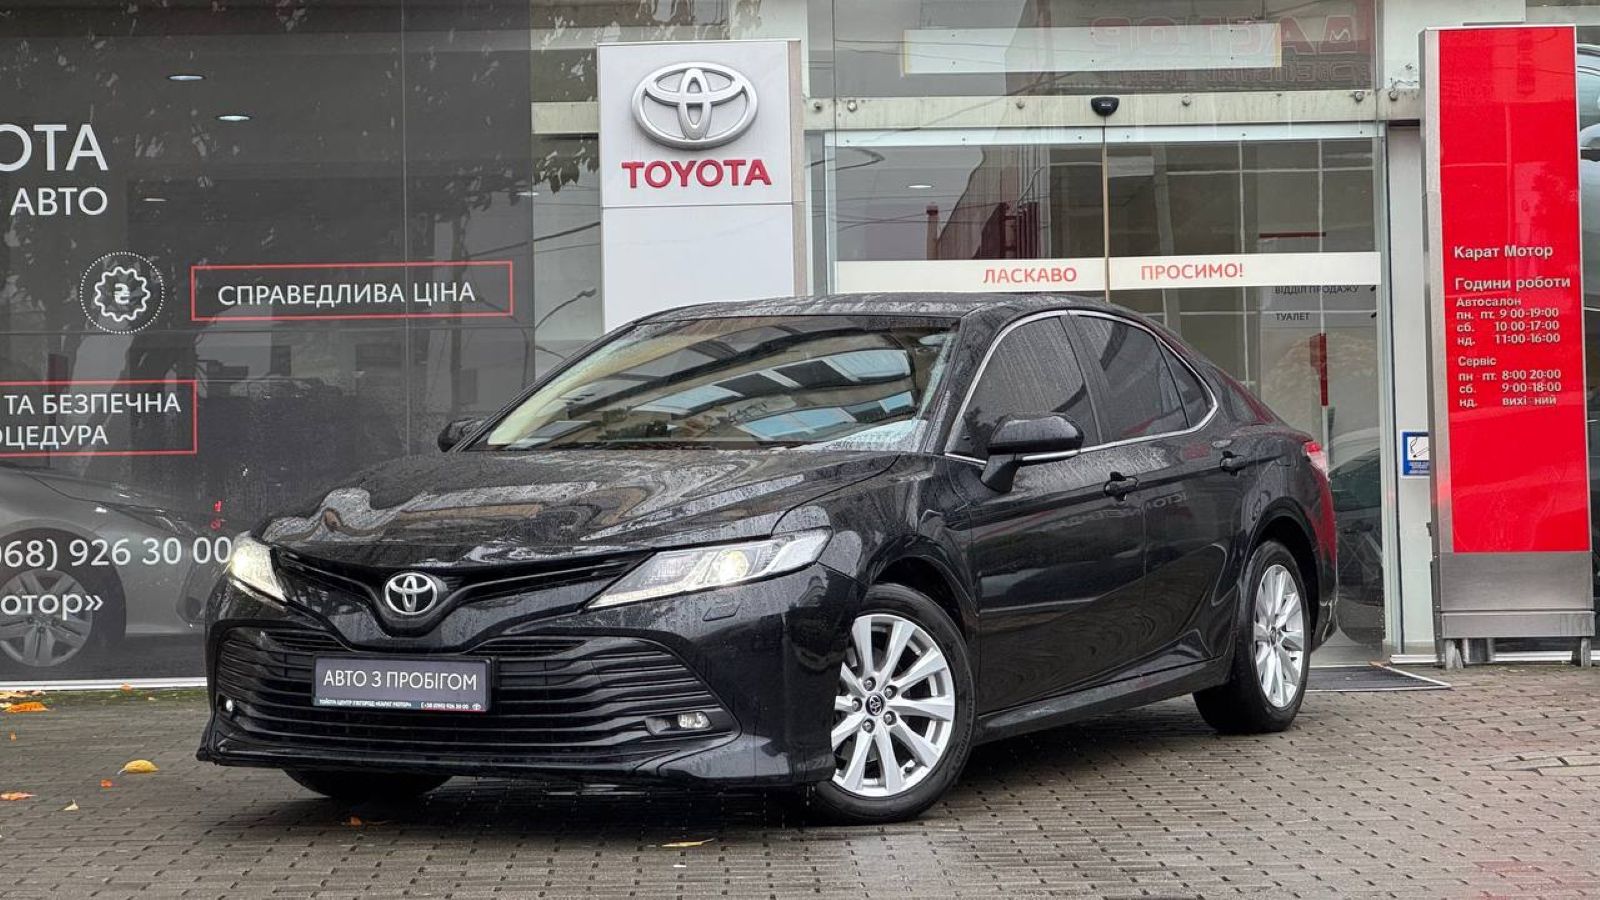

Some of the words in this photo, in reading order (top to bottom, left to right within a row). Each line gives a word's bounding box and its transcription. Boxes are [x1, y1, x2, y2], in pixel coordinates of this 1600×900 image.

[621, 159, 772, 189] TOYOTA
[9, 186, 108, 216] АВТО
[1454, 245, 1500, 261] Карат
[1504, 244, 1553, 259] Мотор
[983, 267, 1077, 284] ЛАСКАВО
[1140, 263, 1243, 281] ПРОСИМО!
[1455, 278, 1511, 292] Години
[1516, 276, 1571, 292] роботи
[217, 283, 405, 309] СПРАВЕДЛИВА
[414, 281, 476, 306] ЦІНА
[1456, 297, 1522, 307] Автосалон
[1275, 312, 1310, 321] ТУАЛЕТ
[1456, 322, 1475, 332] сб.
[1457, 336, 1476, 346] нд.
[1458, 356, 1496, 367] Сервіс
[3, 394, 35, 415] ТА
[43, 392, 182, 415] БЕЗПЕЧНА
[1459, 398, 1478, 408] нд.
[0, 425, 109, 450] ЦЕДУРА
[0, 538, 58, 571] 68)
[69, 538, 131, 567] 926
[142, 537, 182, 566] 30
[193, 536, 232, 564] 00
[323, 669, 367, 687] АВТО
[371, 670, 382, 687] З
[386, 671, 477, 691] ПРОБІГОМ
